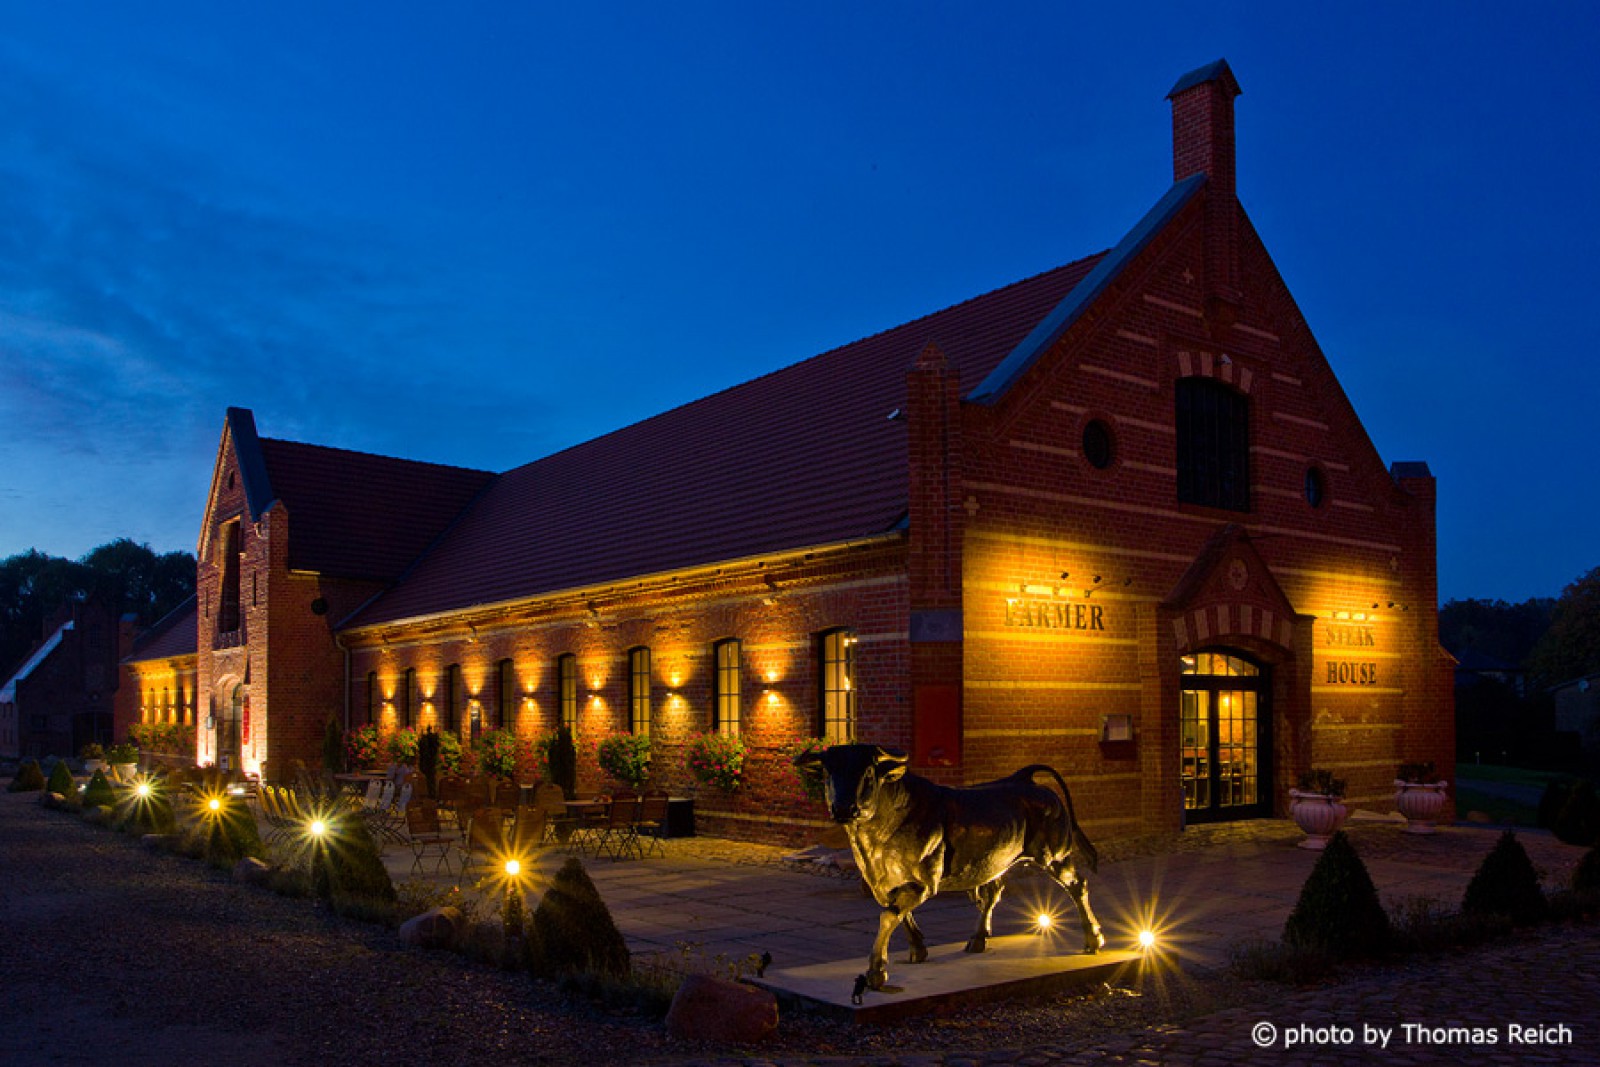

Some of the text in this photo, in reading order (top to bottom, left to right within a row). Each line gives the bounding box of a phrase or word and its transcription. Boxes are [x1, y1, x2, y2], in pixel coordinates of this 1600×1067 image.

[1004, 600, 1105, 631] FARMER
[1326, 625, 1375, 647] STEAK
[1326, 661, 1377, 684] HOUSE
